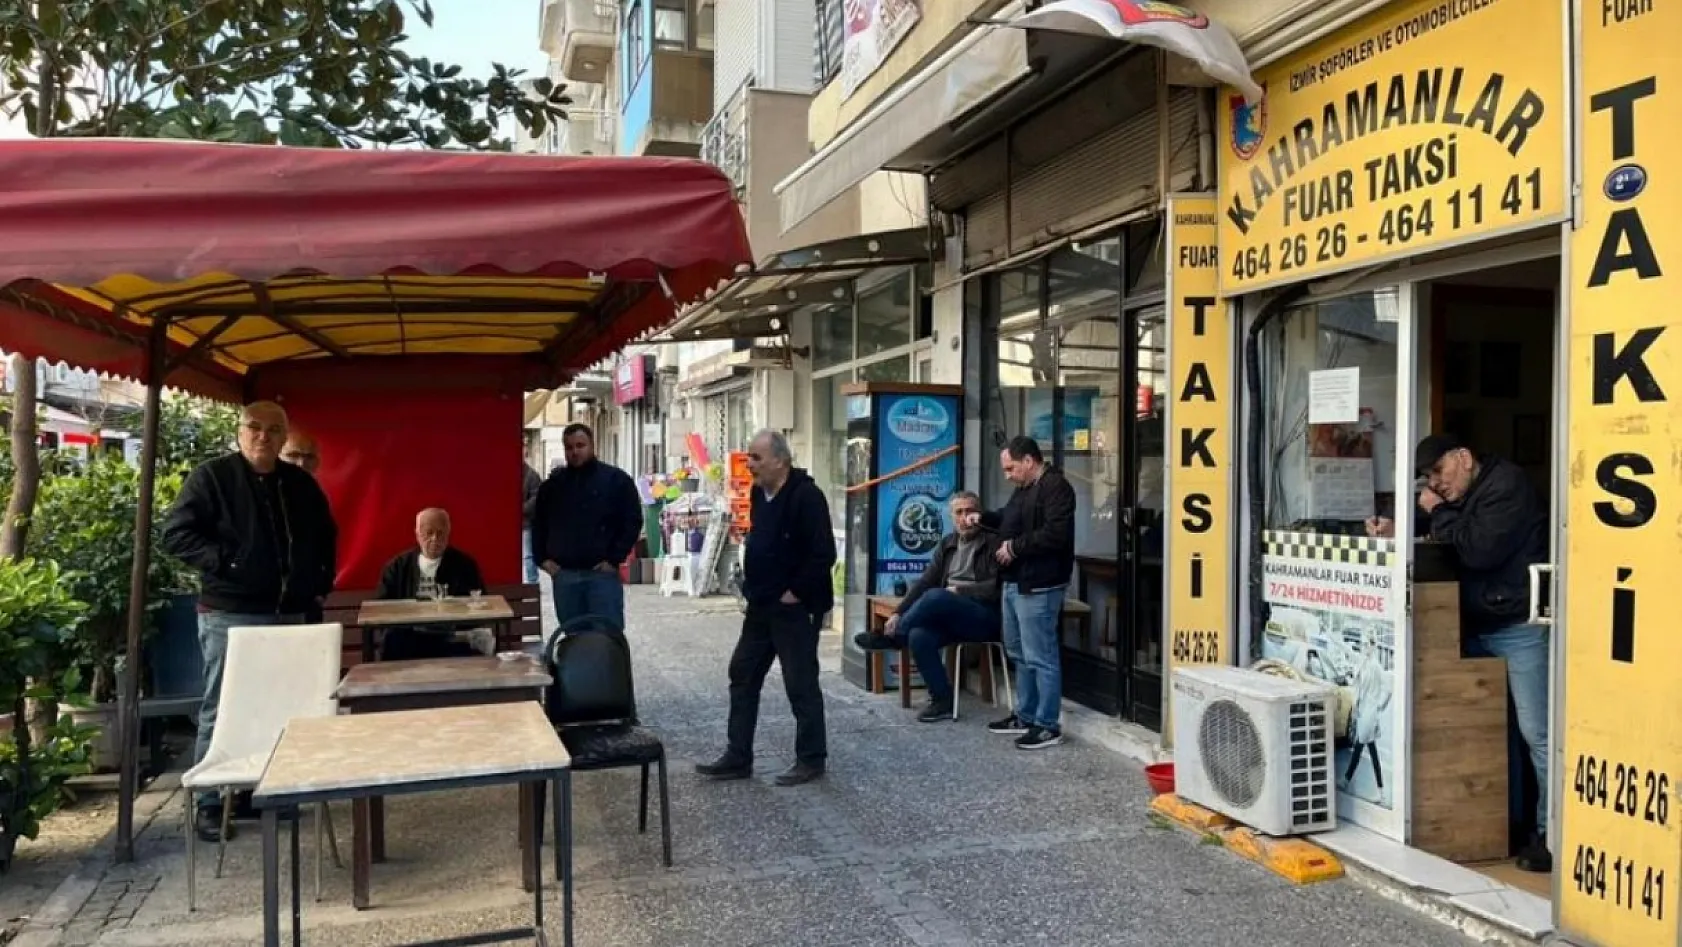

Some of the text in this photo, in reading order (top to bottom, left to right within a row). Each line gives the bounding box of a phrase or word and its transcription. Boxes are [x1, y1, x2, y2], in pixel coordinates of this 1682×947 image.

[1319, 40, 1374, 84] ŞOFÖRLER
[1377, 31, 1393, 53] VE
[1227, 67, 1544, 235] KAHRAMANLAR
[1232, 167, 1541, 280] 464 26 26 - 464 11 41
[1284, 169, 1353, 226] FUAR
[1180, 245, 1219, 268] FUAR
[1266, 562, 1331, 580] KAHRAMANLAR
[1335, 569, 1360, 585] FUAR
[1270, 582, 1385, 613] 7/24 HİZMETİNİZDE
[1174, 630, 1219, 663] 464 26 26
[1574, 754, 1669, 826] 464 26 26
[1573, 844, 1665, 921] 464 11 41
